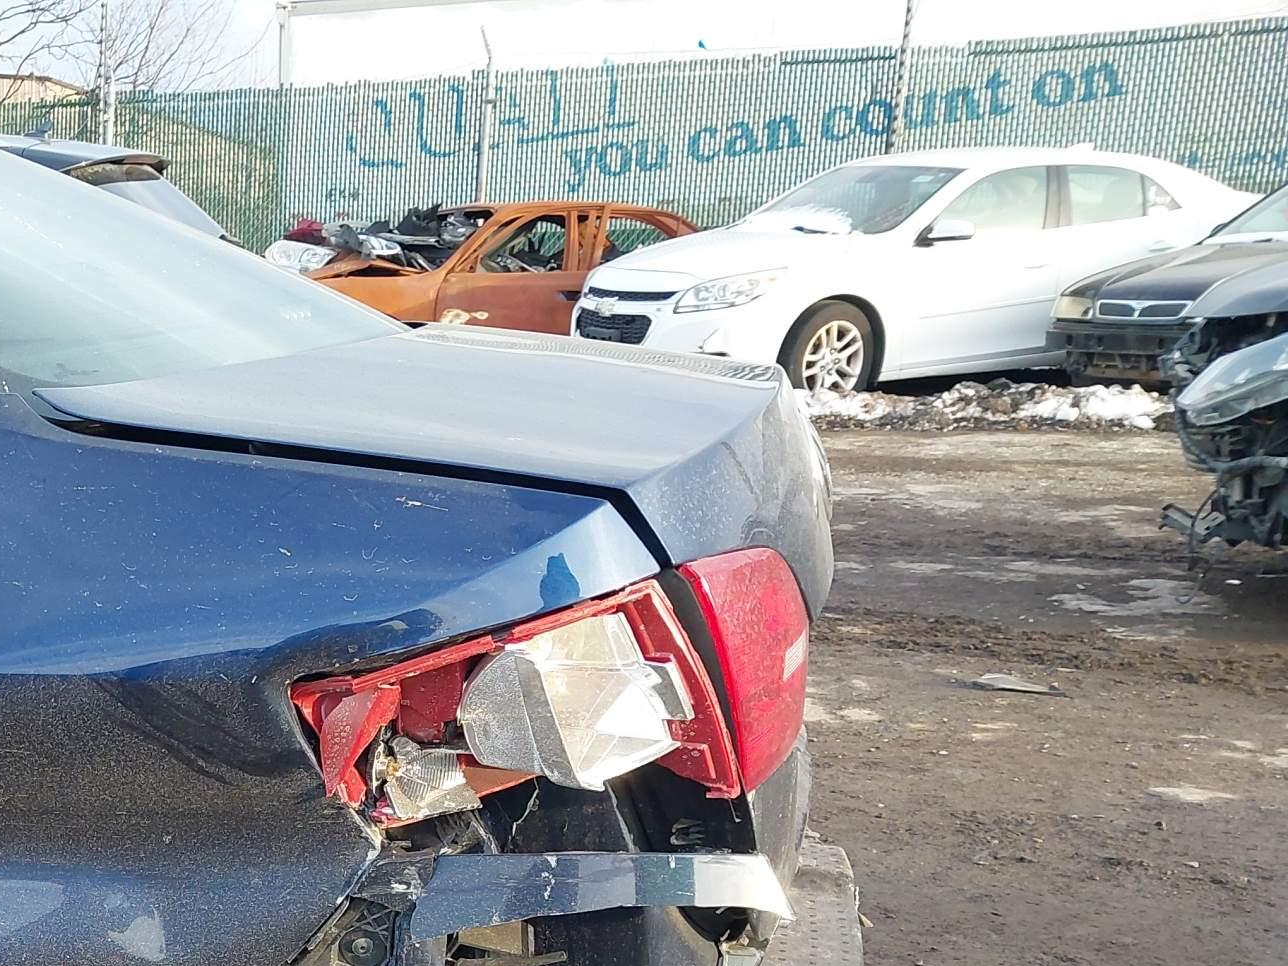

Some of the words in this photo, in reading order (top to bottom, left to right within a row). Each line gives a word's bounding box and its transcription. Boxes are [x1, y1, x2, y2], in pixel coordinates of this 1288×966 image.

[564, 138, 669, 193] you
[687, 114, 806, 163] can
[820, 66, 1014, 142] count
[1031, 61, 1125, 108] on
